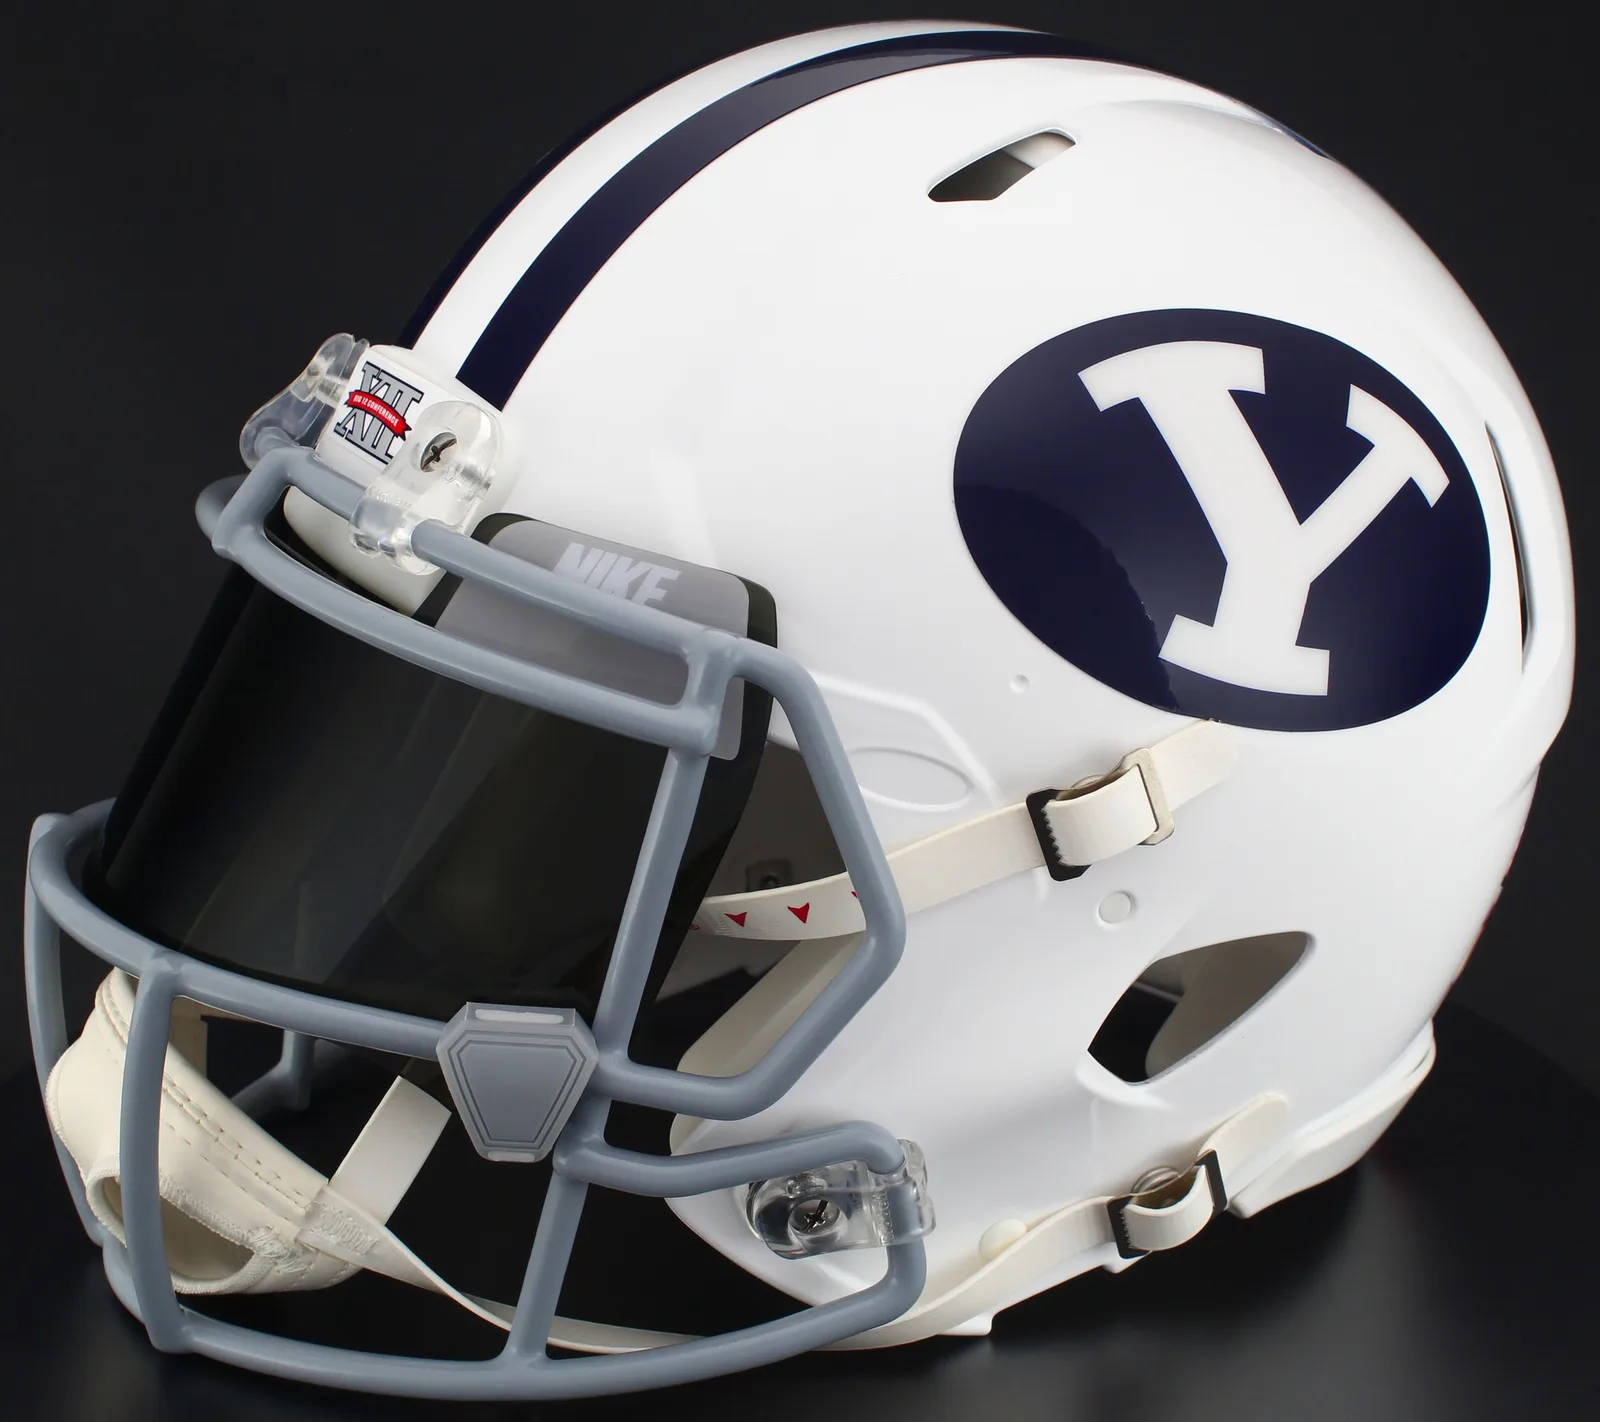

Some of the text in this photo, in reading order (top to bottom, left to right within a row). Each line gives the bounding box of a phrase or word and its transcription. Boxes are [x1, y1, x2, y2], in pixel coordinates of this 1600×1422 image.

[353, 395, 363, 403] BIG
[367, 399, 399, 427] CONFERENCE
[1077, 340, 1450, 696] Y
[552, 541, 682, 605] NIKE
